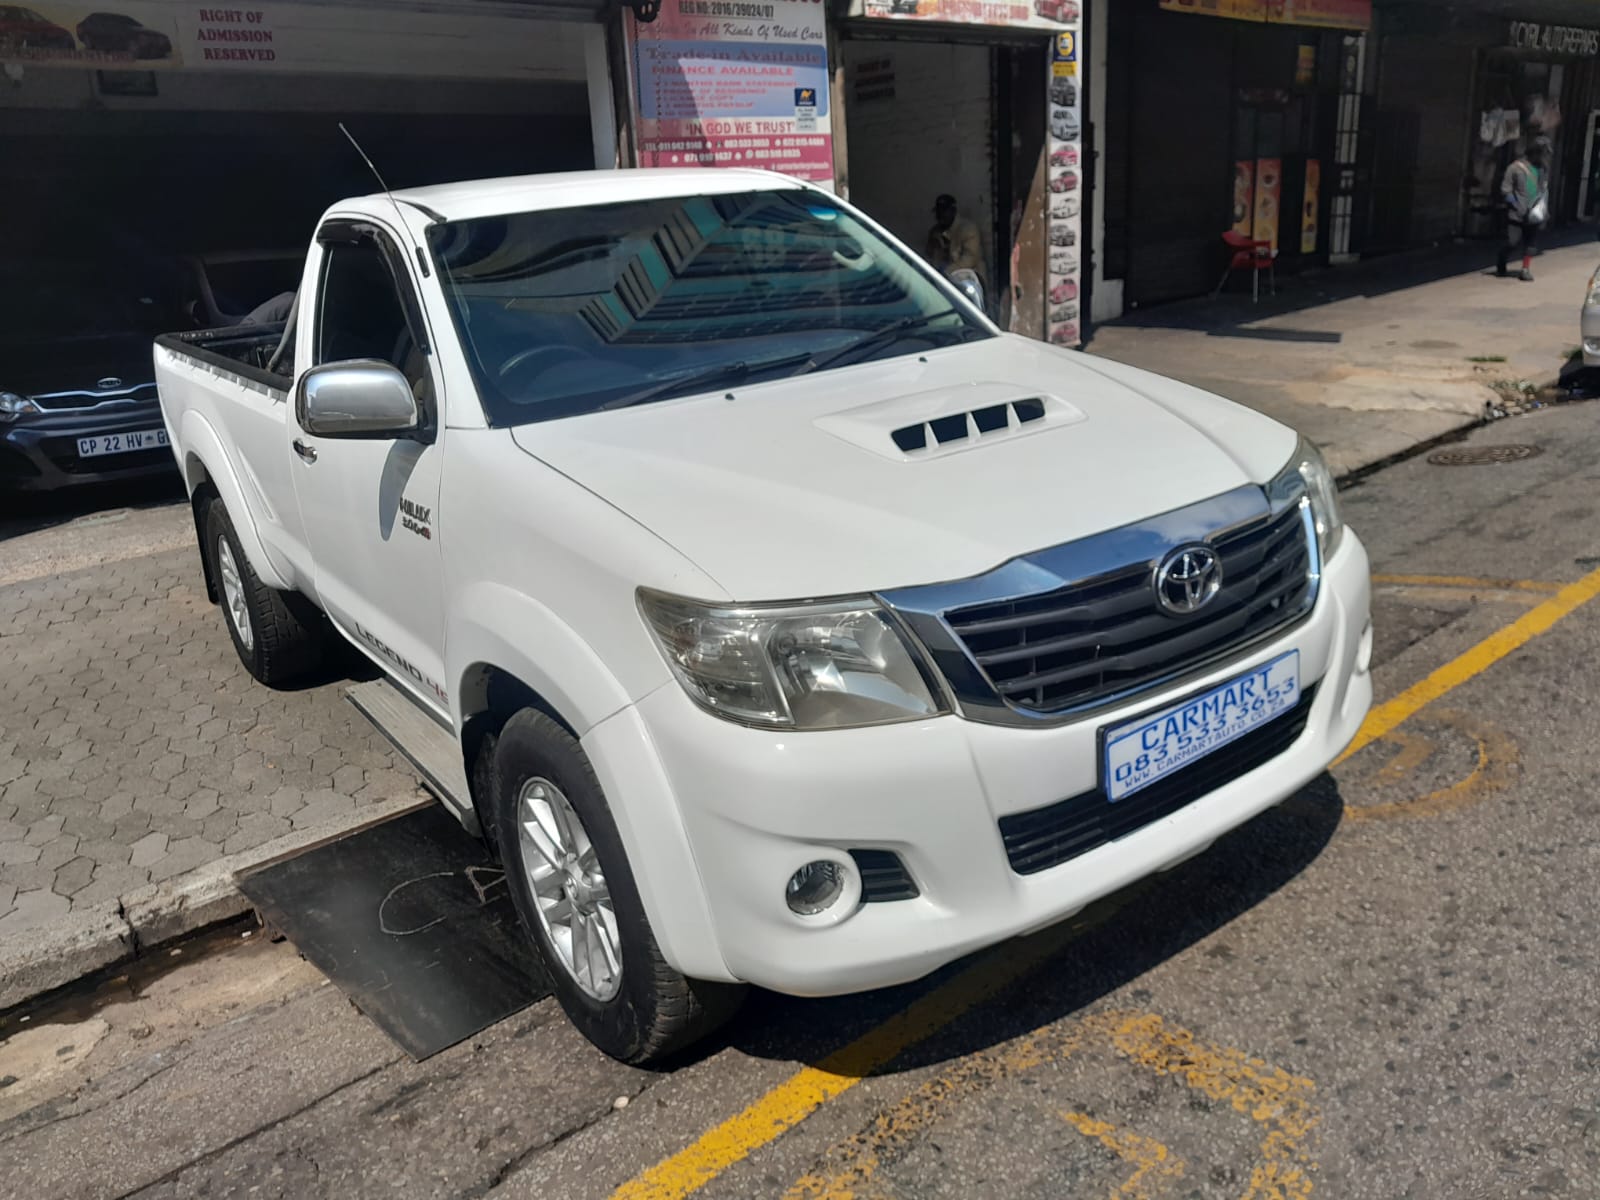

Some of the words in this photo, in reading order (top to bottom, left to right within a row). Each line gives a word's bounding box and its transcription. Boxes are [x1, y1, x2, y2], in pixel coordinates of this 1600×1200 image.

[200, 9, 242, 22] RIGHT
[246, 11, 264, 23] OF
[197, 28, 273, 42] ADMISSION
[699, 22, 719, 36] All
[723, 22, 753, 36] Kinds
[757, 24, 770, 40] Of
[772, 25, 798, 38] Used
[800, 26, 823, 40] Cars
[203, 47, 276, 61] RESERVED
[652, 66, 716, 75] FINANCE
[720, 66, 794, 76] AVAILABLE
[706, 122, 730, 135] GOD
[735, 122, 752, 133] WE
[80, 440, 97, 454] CP
[103, 436, 121, 452] 22
[126, 433, 142, 448] HV
[355, 622, 423, 682] LEGEND
[1142, 667, 1273, 751] CARMART
[1115, 743, 1168, 782] 083
[1178, 713, 1227, 750] 533
[1236, 676, 1295, 720] 3653
